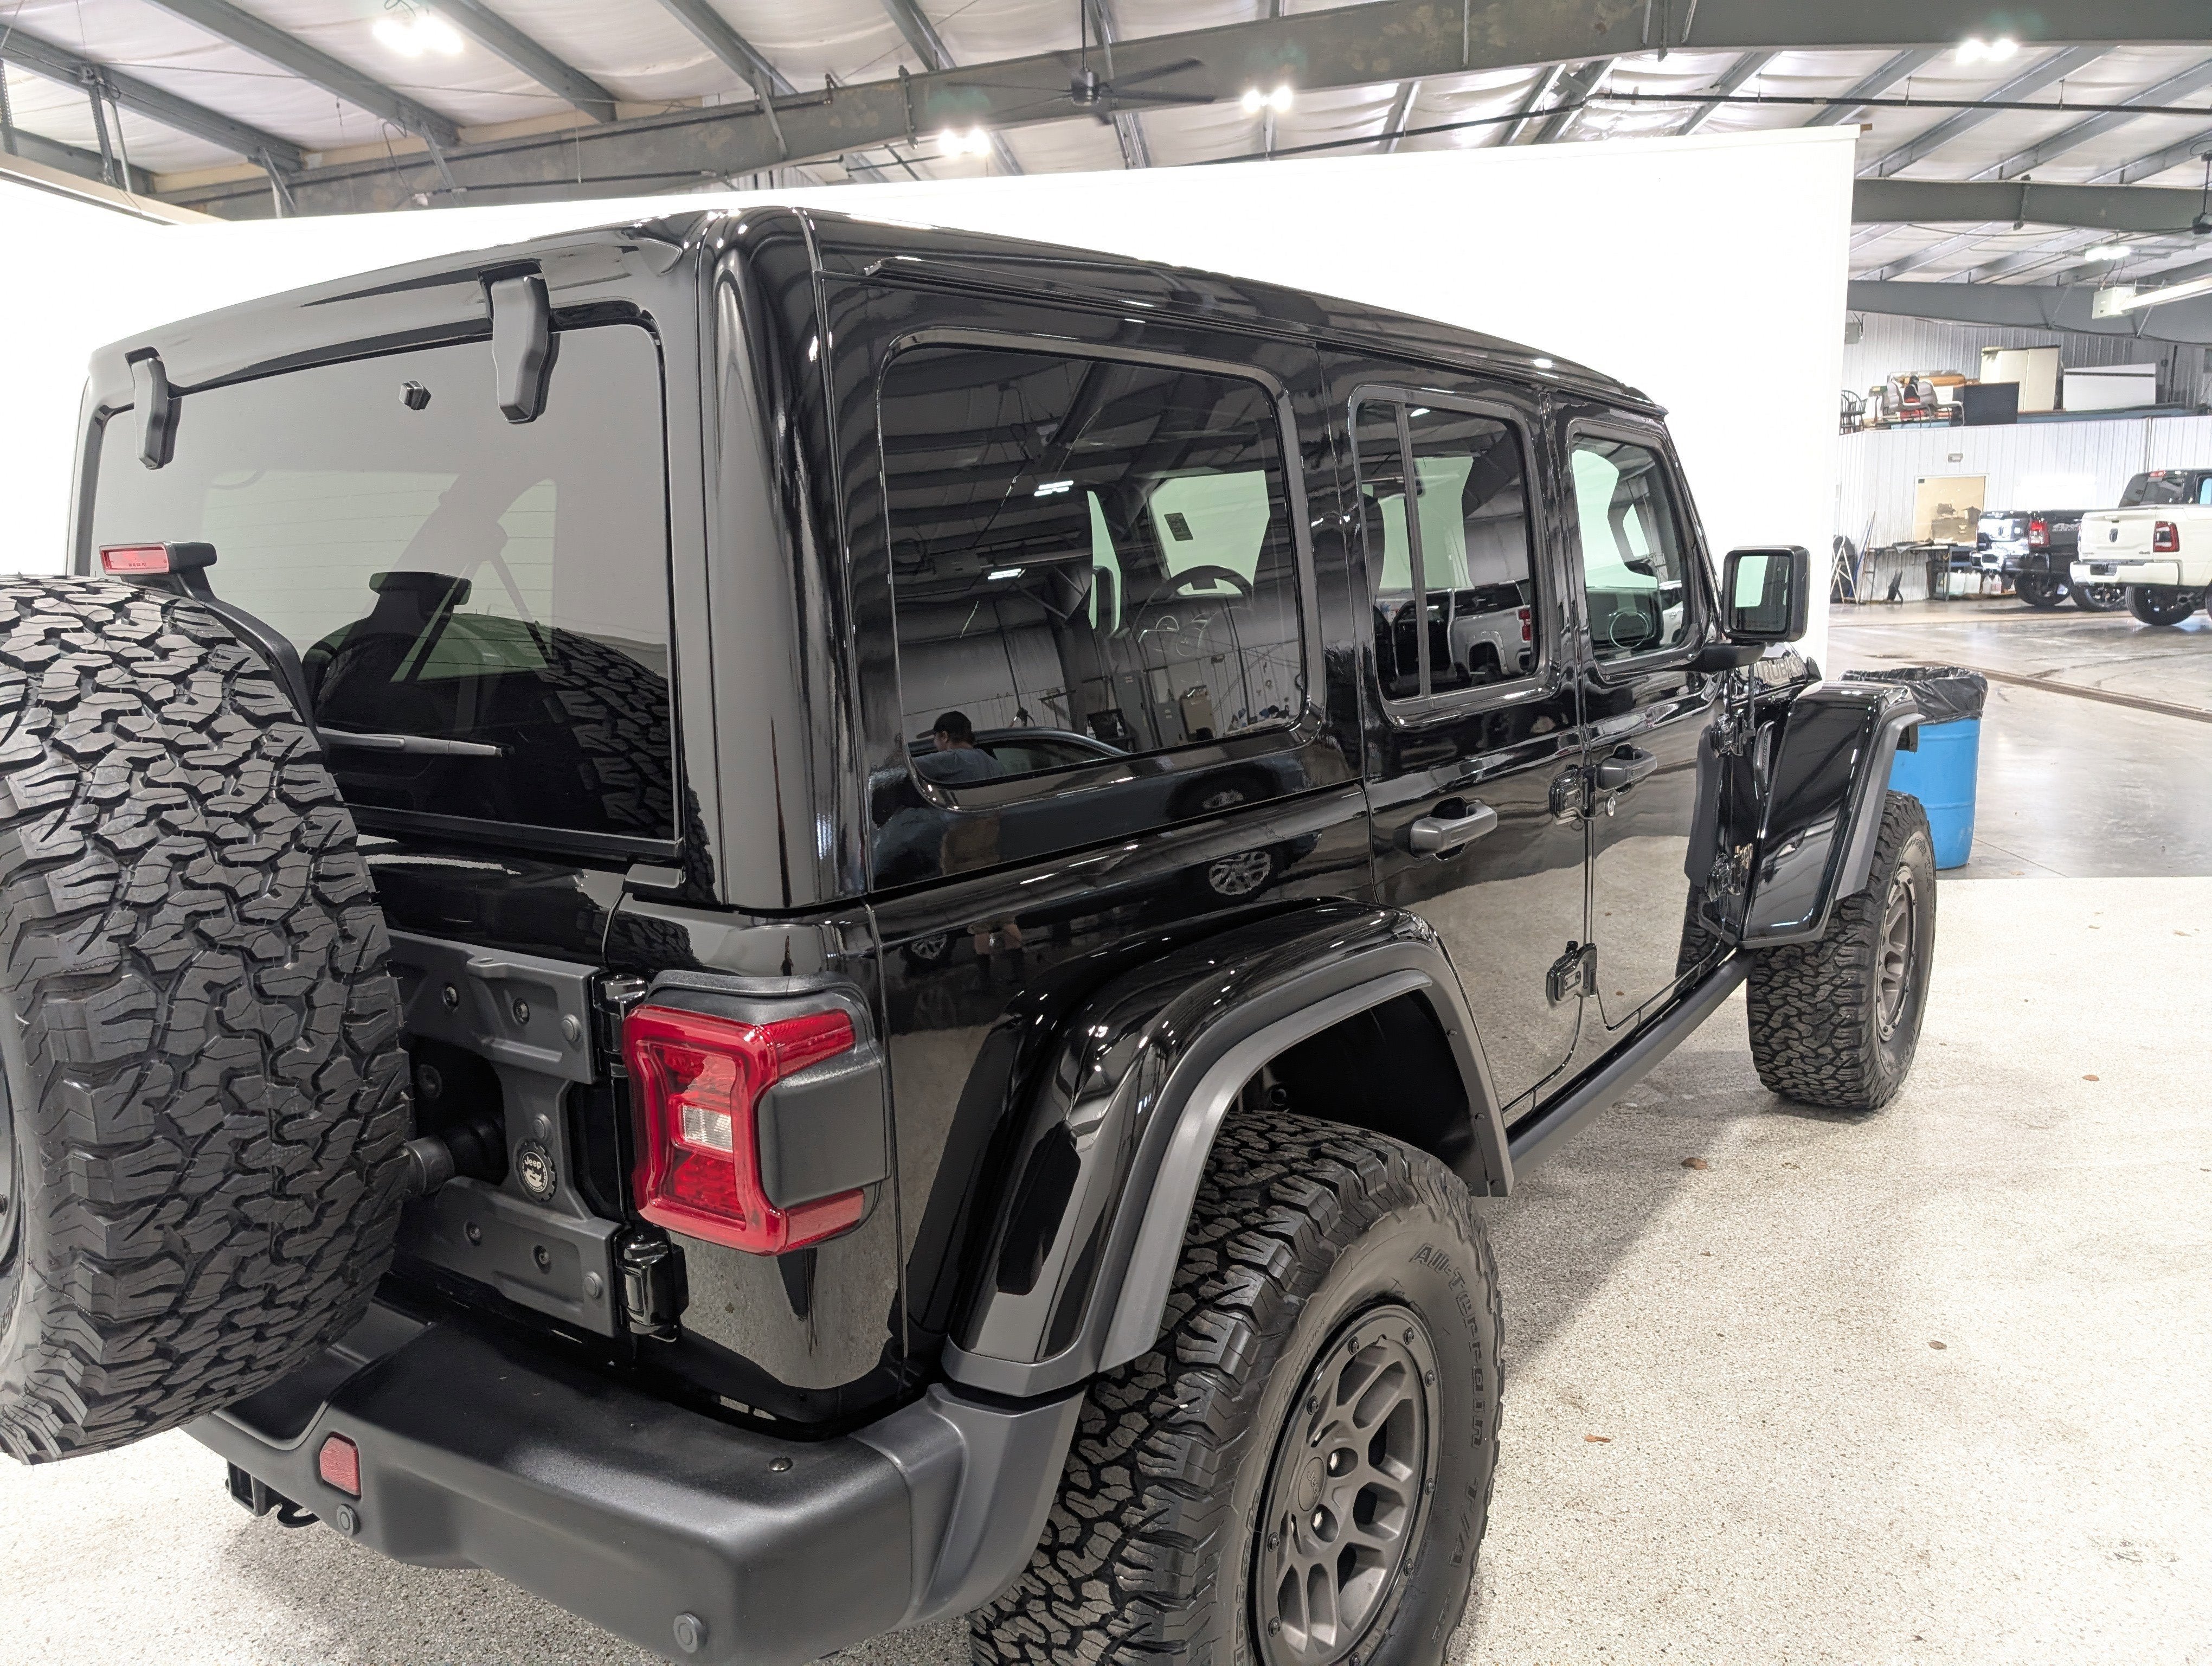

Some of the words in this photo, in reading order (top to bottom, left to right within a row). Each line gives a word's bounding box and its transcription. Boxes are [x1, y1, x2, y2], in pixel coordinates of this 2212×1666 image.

[524, 1156, 542, 1170] Jeep
[1409, 1244, 1486, 1449] All-Terrain
[1449, 1477, 1478, 1568] T/A
[1306, 1470, 1322, 1499] Jeep
